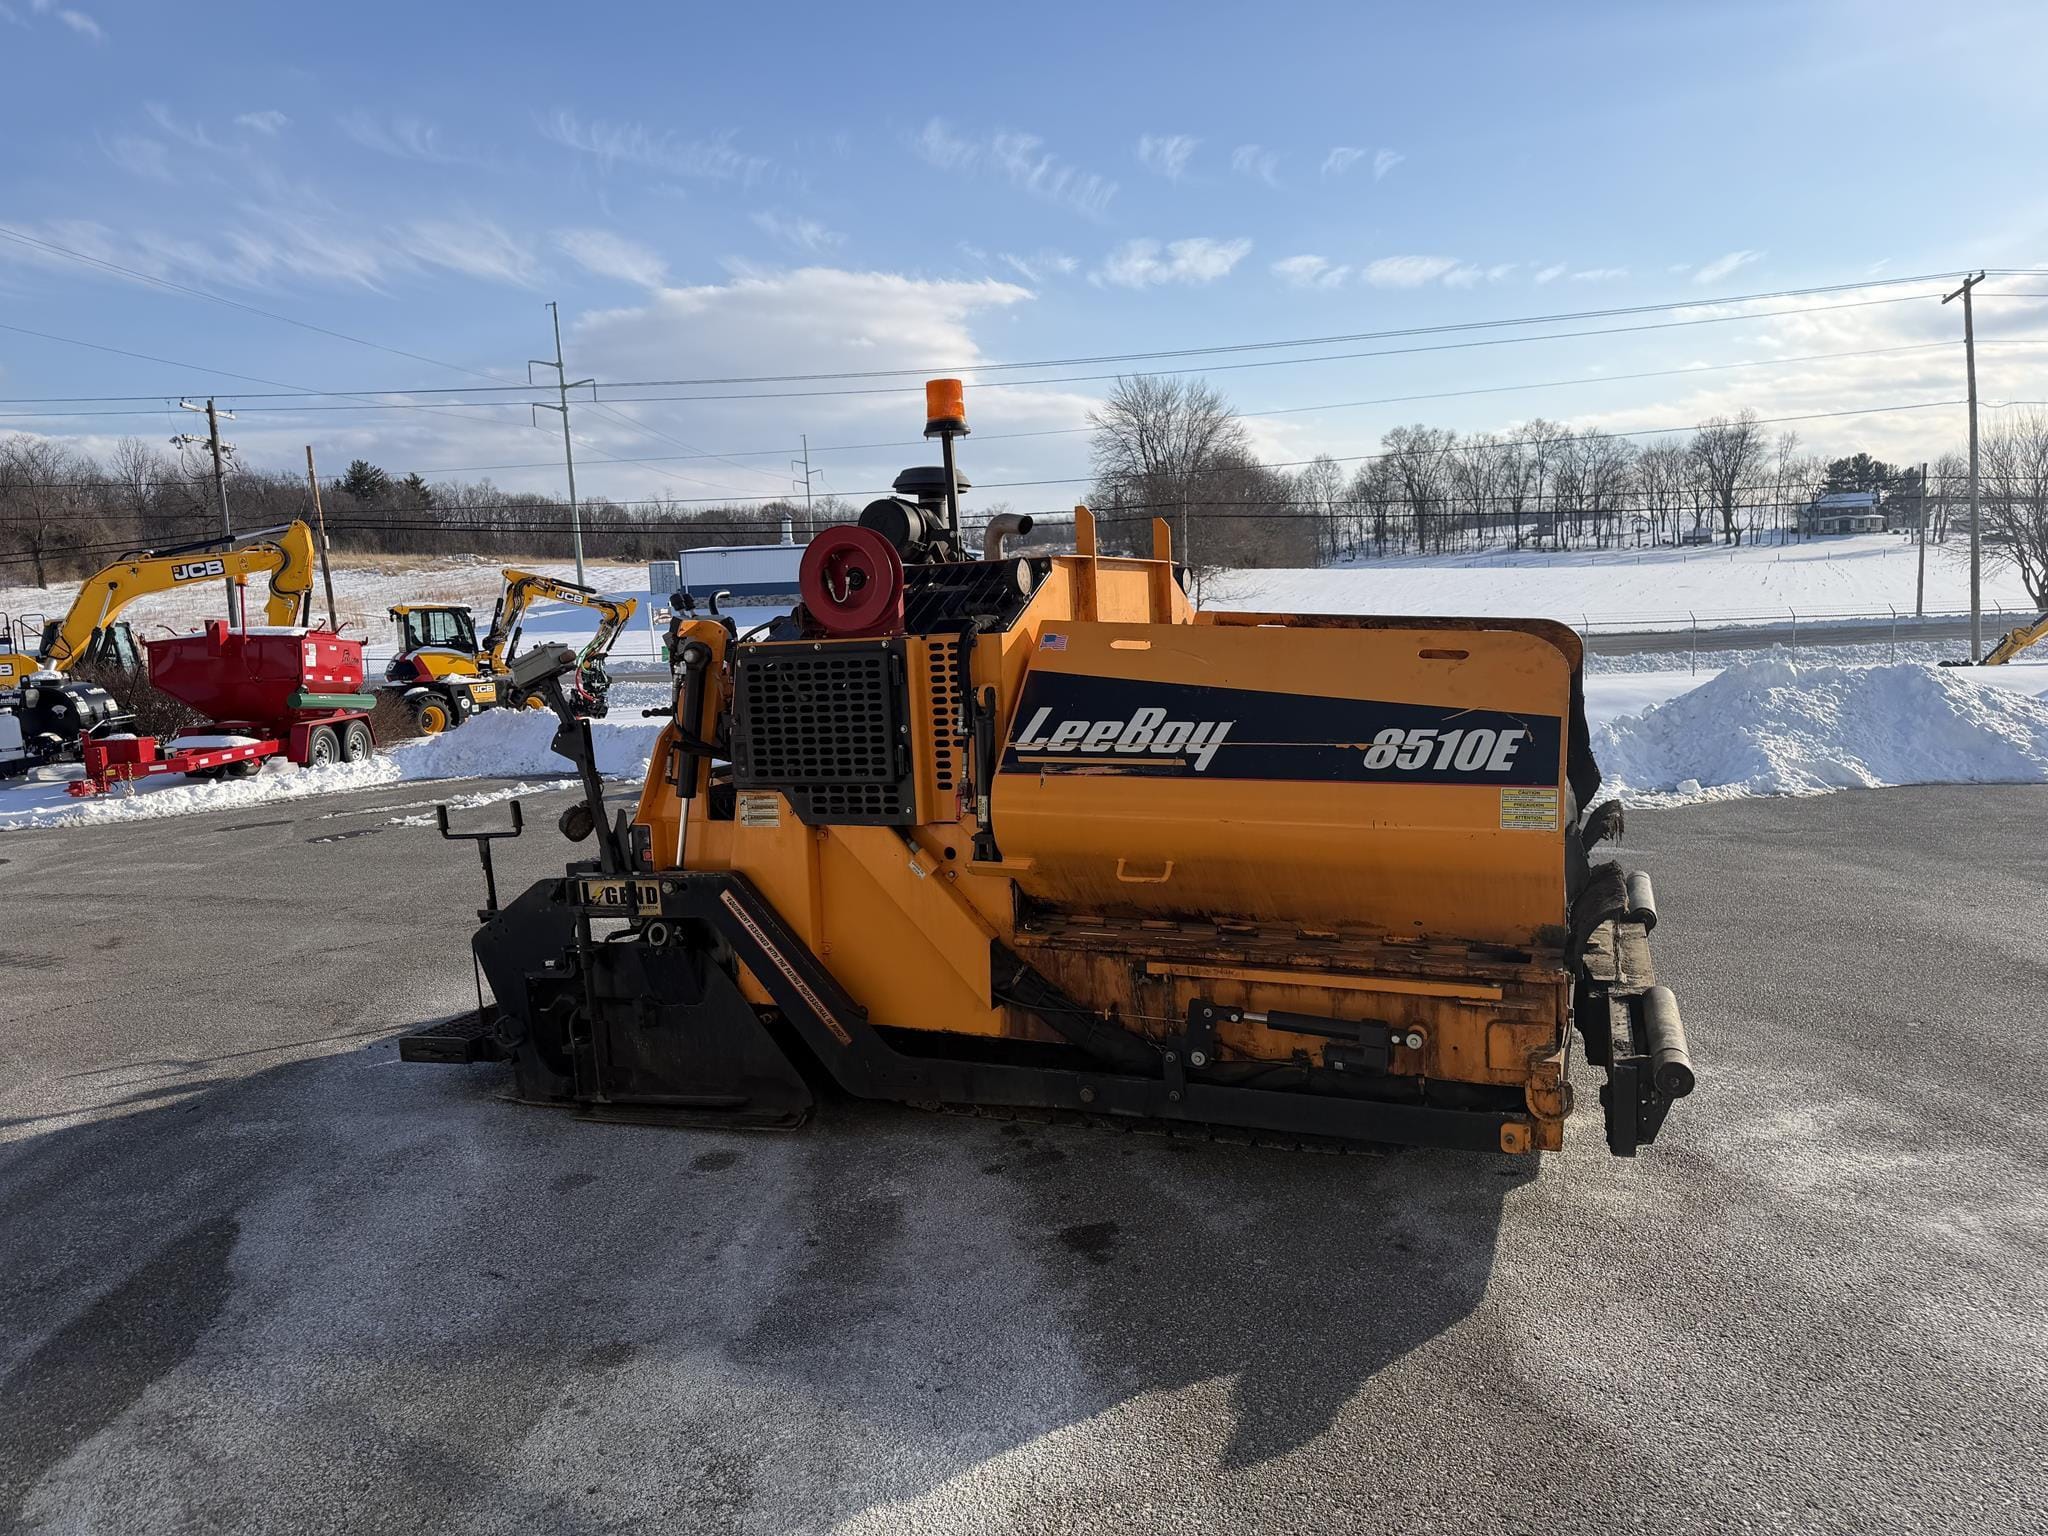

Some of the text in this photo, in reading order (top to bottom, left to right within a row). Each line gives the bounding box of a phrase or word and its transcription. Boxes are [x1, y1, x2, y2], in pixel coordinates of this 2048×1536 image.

[173, 560, 224, 580] JCB
[556, 590, 583, 603] JCB
[473, 685, 494, 693] JCB
[1014, 707, 1234, 771] LeeBoy
[1363, 728, 1526, 771] 8510E
[749, 922, 770, 947] DESIGNED
[776, 956, 788, 969] THE
[784, 966, 802, 986] PAVING
[799, 984, 828, 1018] PROFESSIONAL
